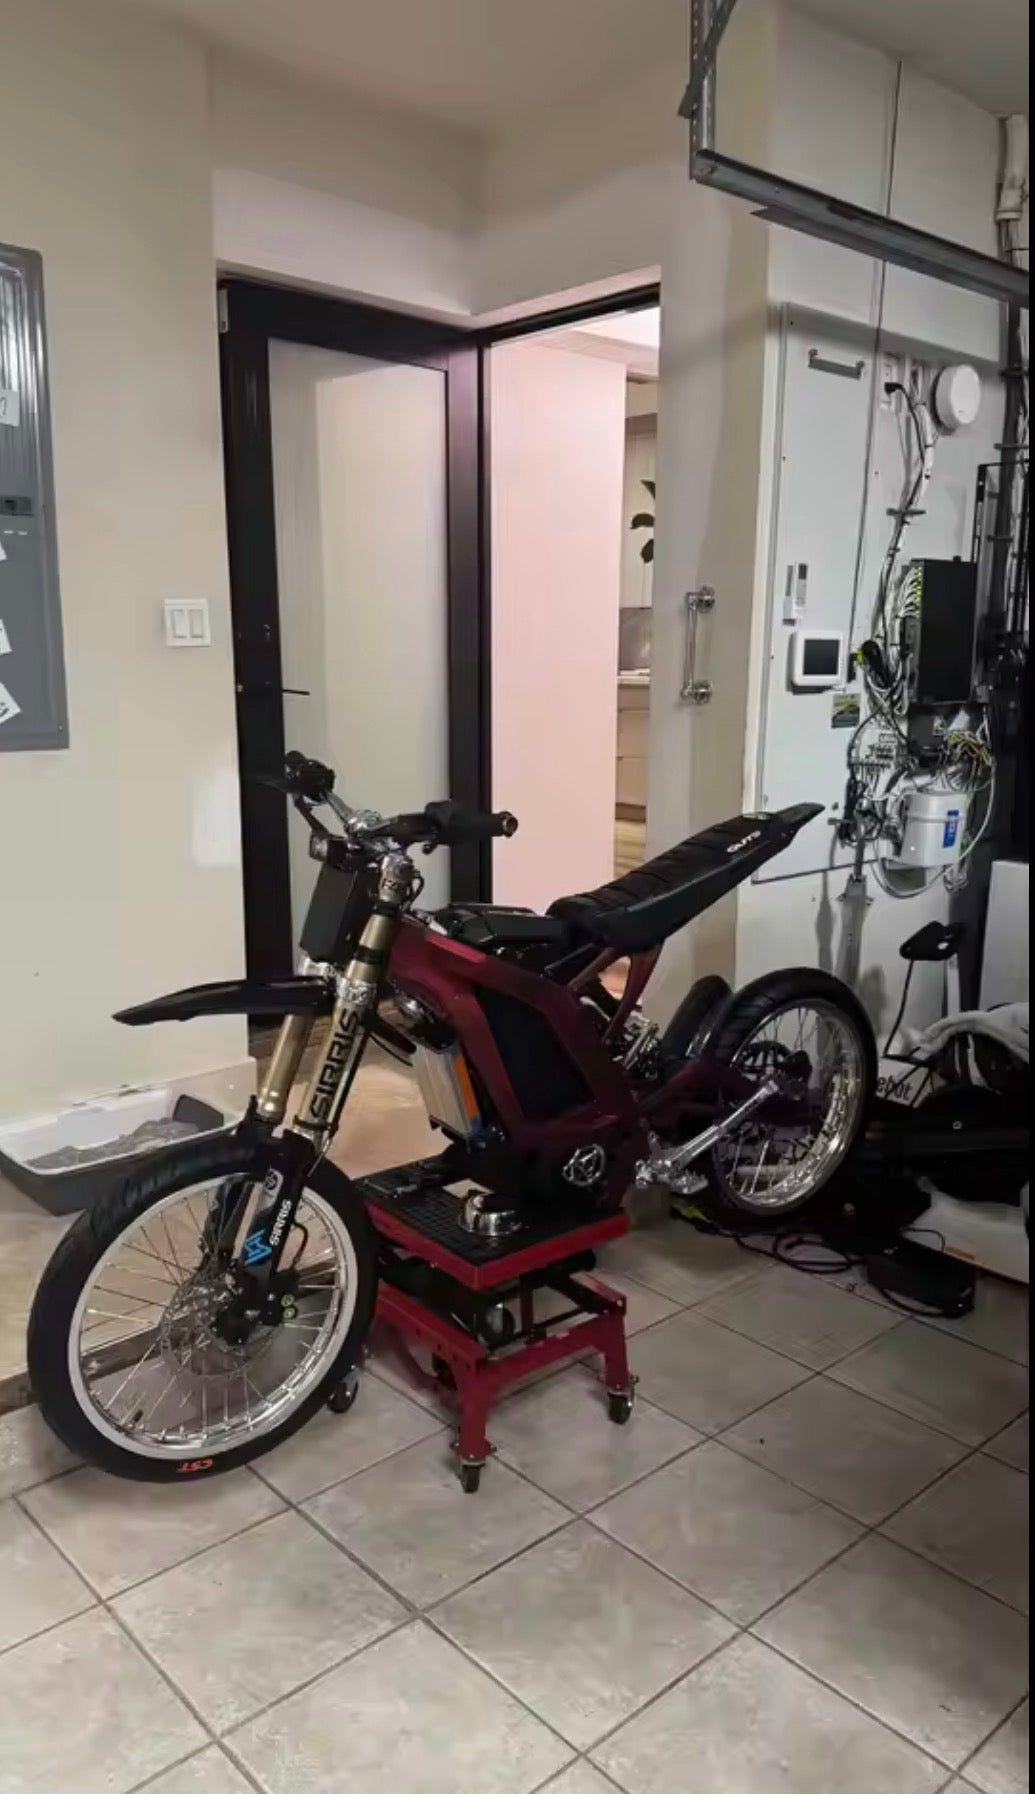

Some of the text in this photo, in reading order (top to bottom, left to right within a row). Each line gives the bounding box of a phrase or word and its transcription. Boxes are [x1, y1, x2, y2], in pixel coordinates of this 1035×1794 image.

[309, 1007, 358, 1119] SIRRIS
[269, 1199, 292, 1246] SIRRIS
[177, 1457, 213, 1472] CST
